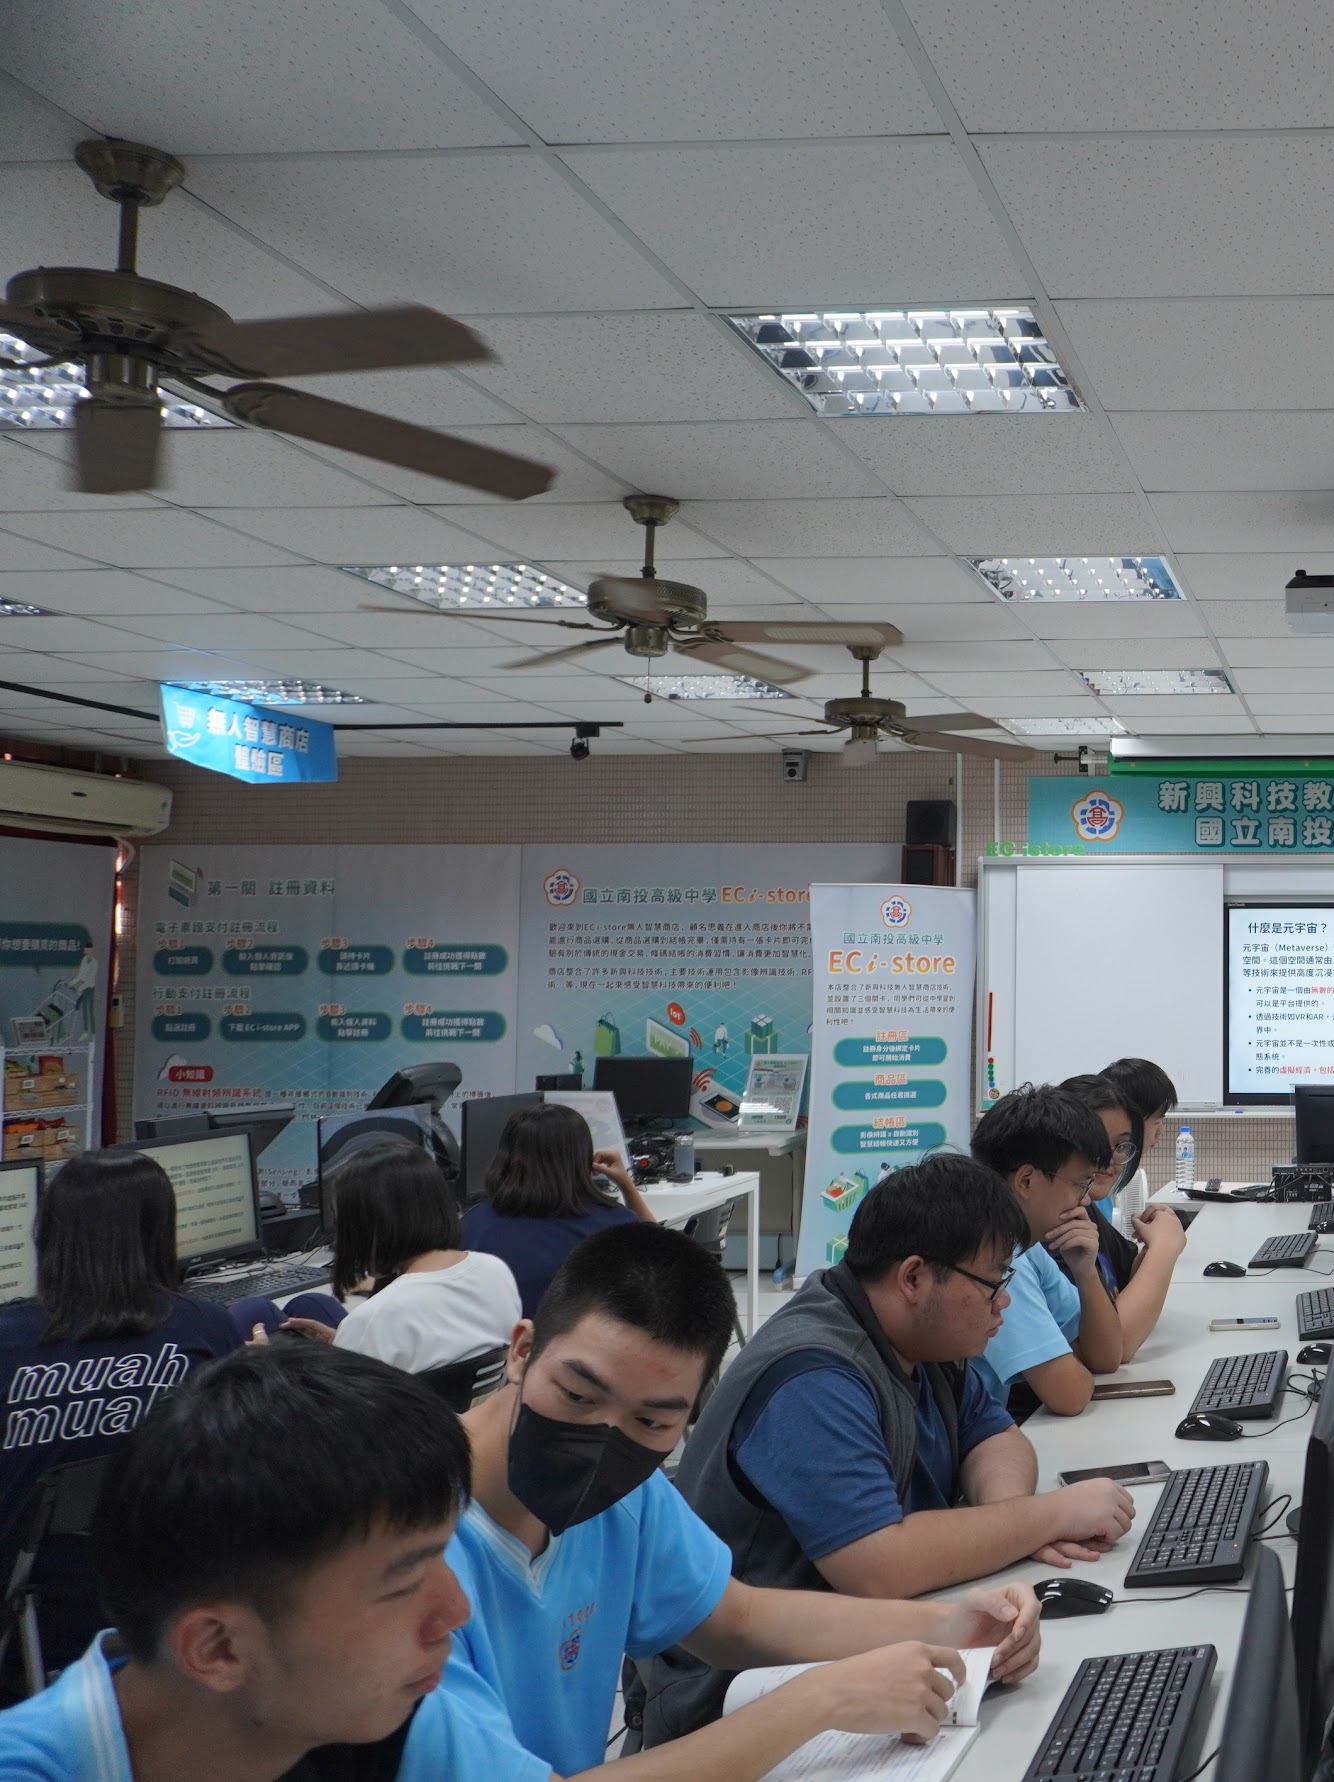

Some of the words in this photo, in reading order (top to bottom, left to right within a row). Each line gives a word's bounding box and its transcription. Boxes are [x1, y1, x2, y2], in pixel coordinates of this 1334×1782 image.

[207, 707, 310, 752] 無人智慧商店
[235, 744, 285, 776] 體驗區
[986, 842, 1016, 856] EC
[208, 880, 256, 895] 第一關
[268, 880, 335, 895] 註冊資料
[583, 888, 717, 903] 國立南投高級中學
[722, 887, 745, 902] EC
[1248, 922, 1328, 934] 什麼是元宇宙？
[843, 932, 944, 945] 國立南投高級中學
[827, 950, 863, 974] EC
[866, 951, 955, 974] i-store
[876, 1030, 908, 1042] 註冊區
[875, 1074, 907, 1085] 商品區
[874, 1117, 906, 1128] 結帳區
[7, 1343, 190, 1404] muah
[3, 1384, 166, 1450] mua
